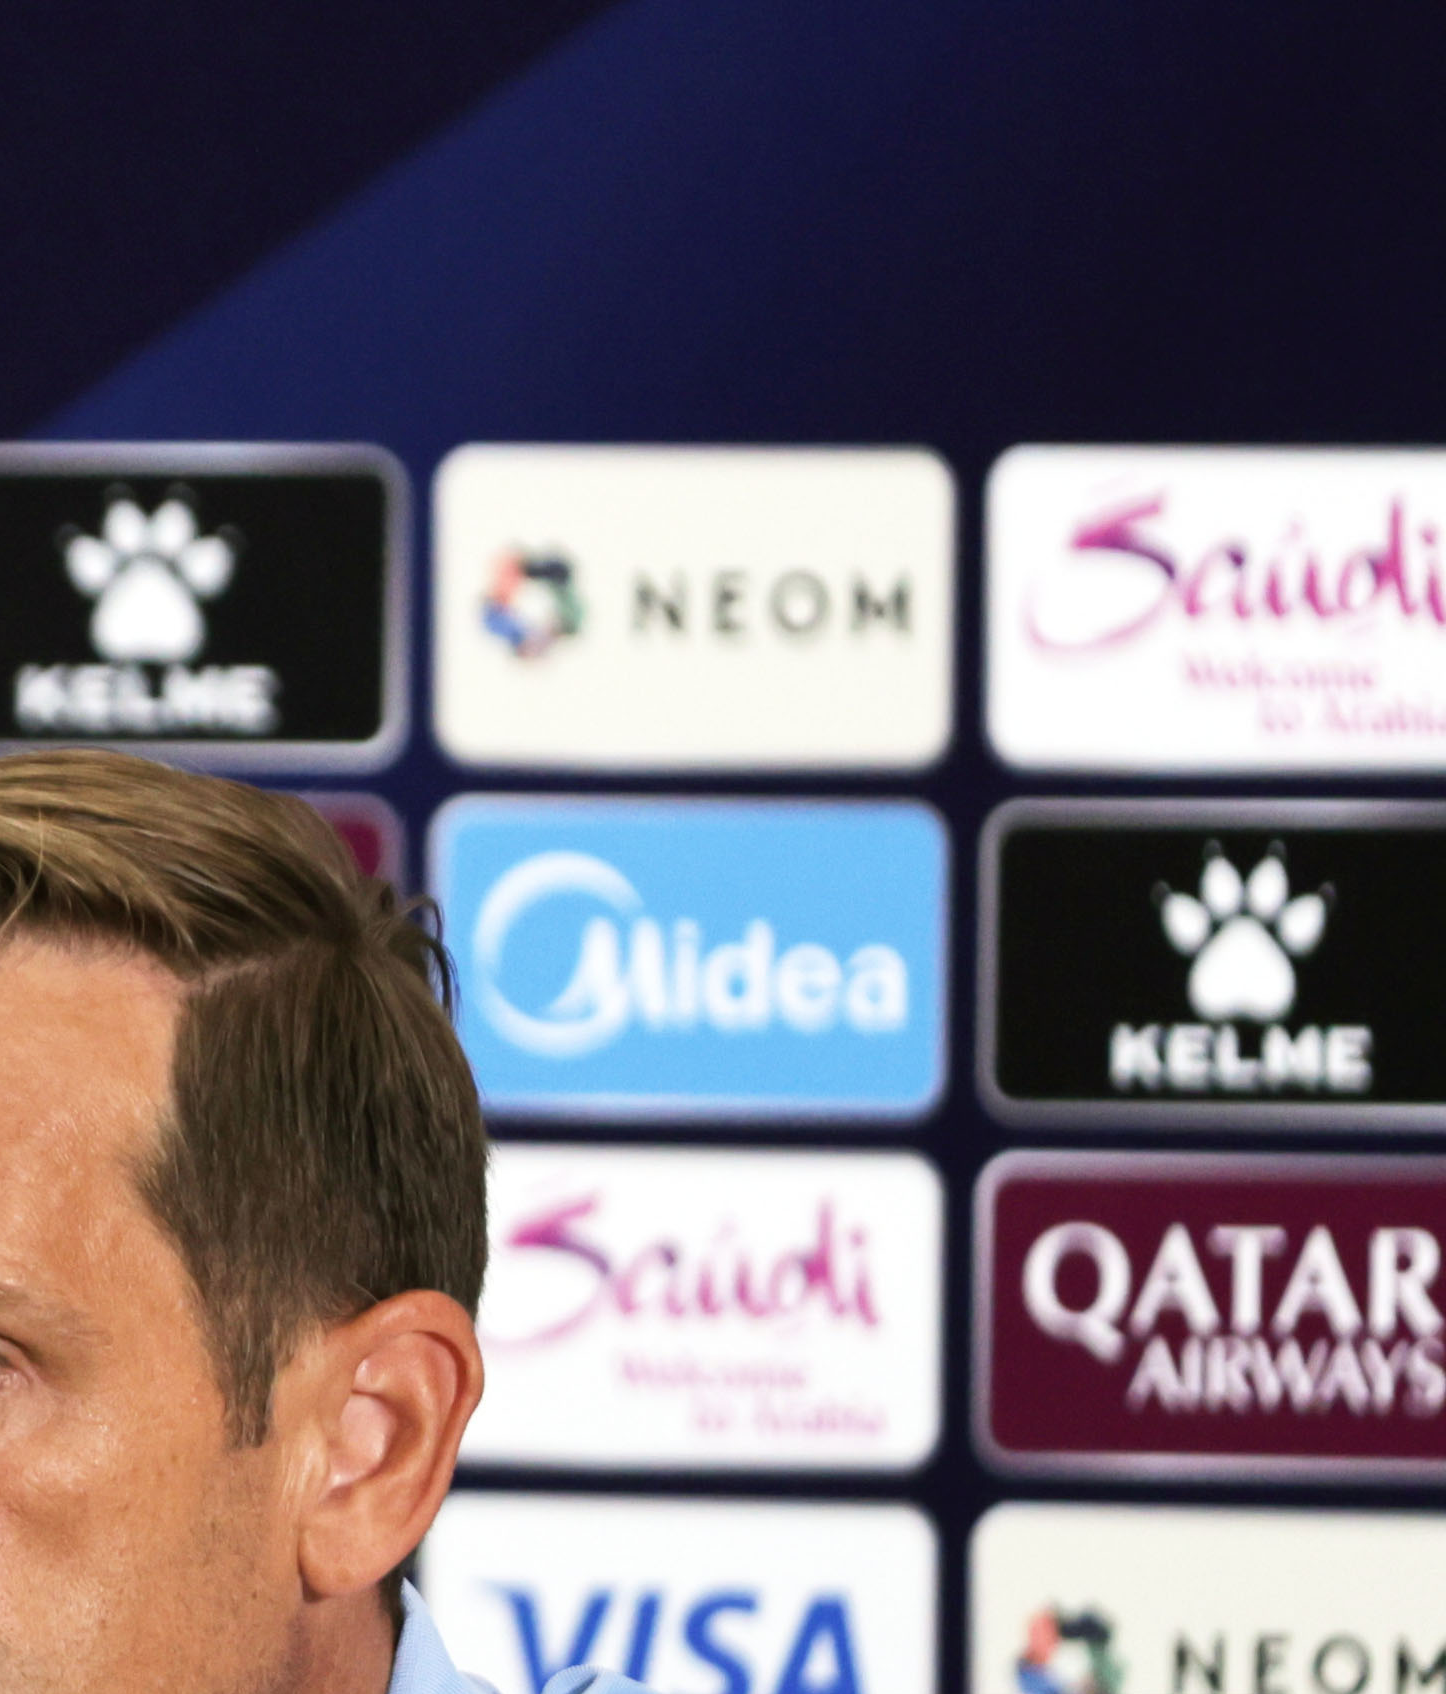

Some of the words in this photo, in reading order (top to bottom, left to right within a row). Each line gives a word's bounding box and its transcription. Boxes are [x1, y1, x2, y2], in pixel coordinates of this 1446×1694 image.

[634, 570, 913, 638] NEOM
[13, 664, 278, 733] KELME
[548, 914, 907, 1034] Midea
[1113, 1025, 1372, 1090] KELME
[1023, 1221, 1443, 1359] QATAR
[1129, 1335, 1446, 1416] AIRWAYS
